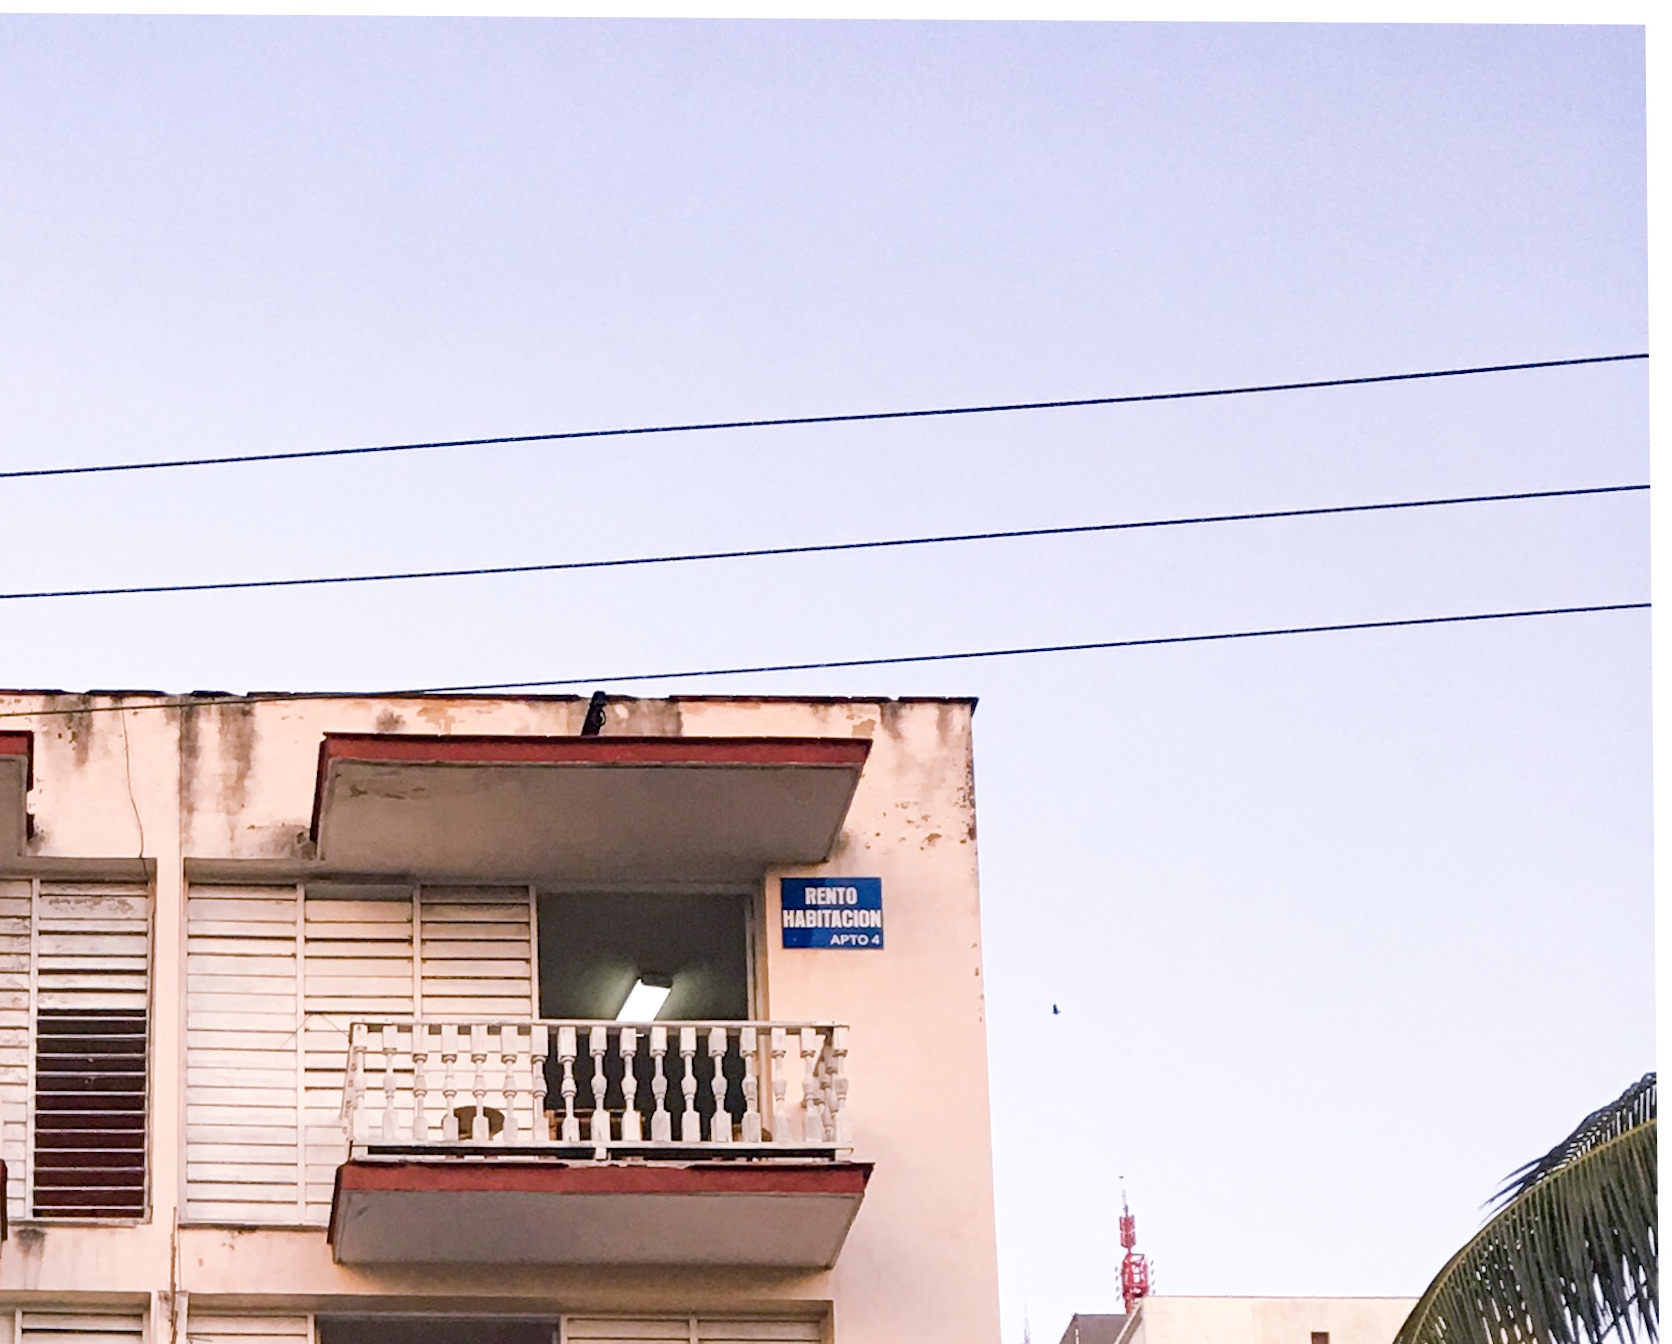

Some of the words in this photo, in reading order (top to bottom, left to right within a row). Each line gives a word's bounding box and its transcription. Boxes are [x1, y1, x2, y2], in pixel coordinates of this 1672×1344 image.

[804, 886, 858, 905] RENTO
[782, 909, 882, 928] HABITACION
[829, 934, 869, 946] APTO
[871, 934, 880, 945] 4
